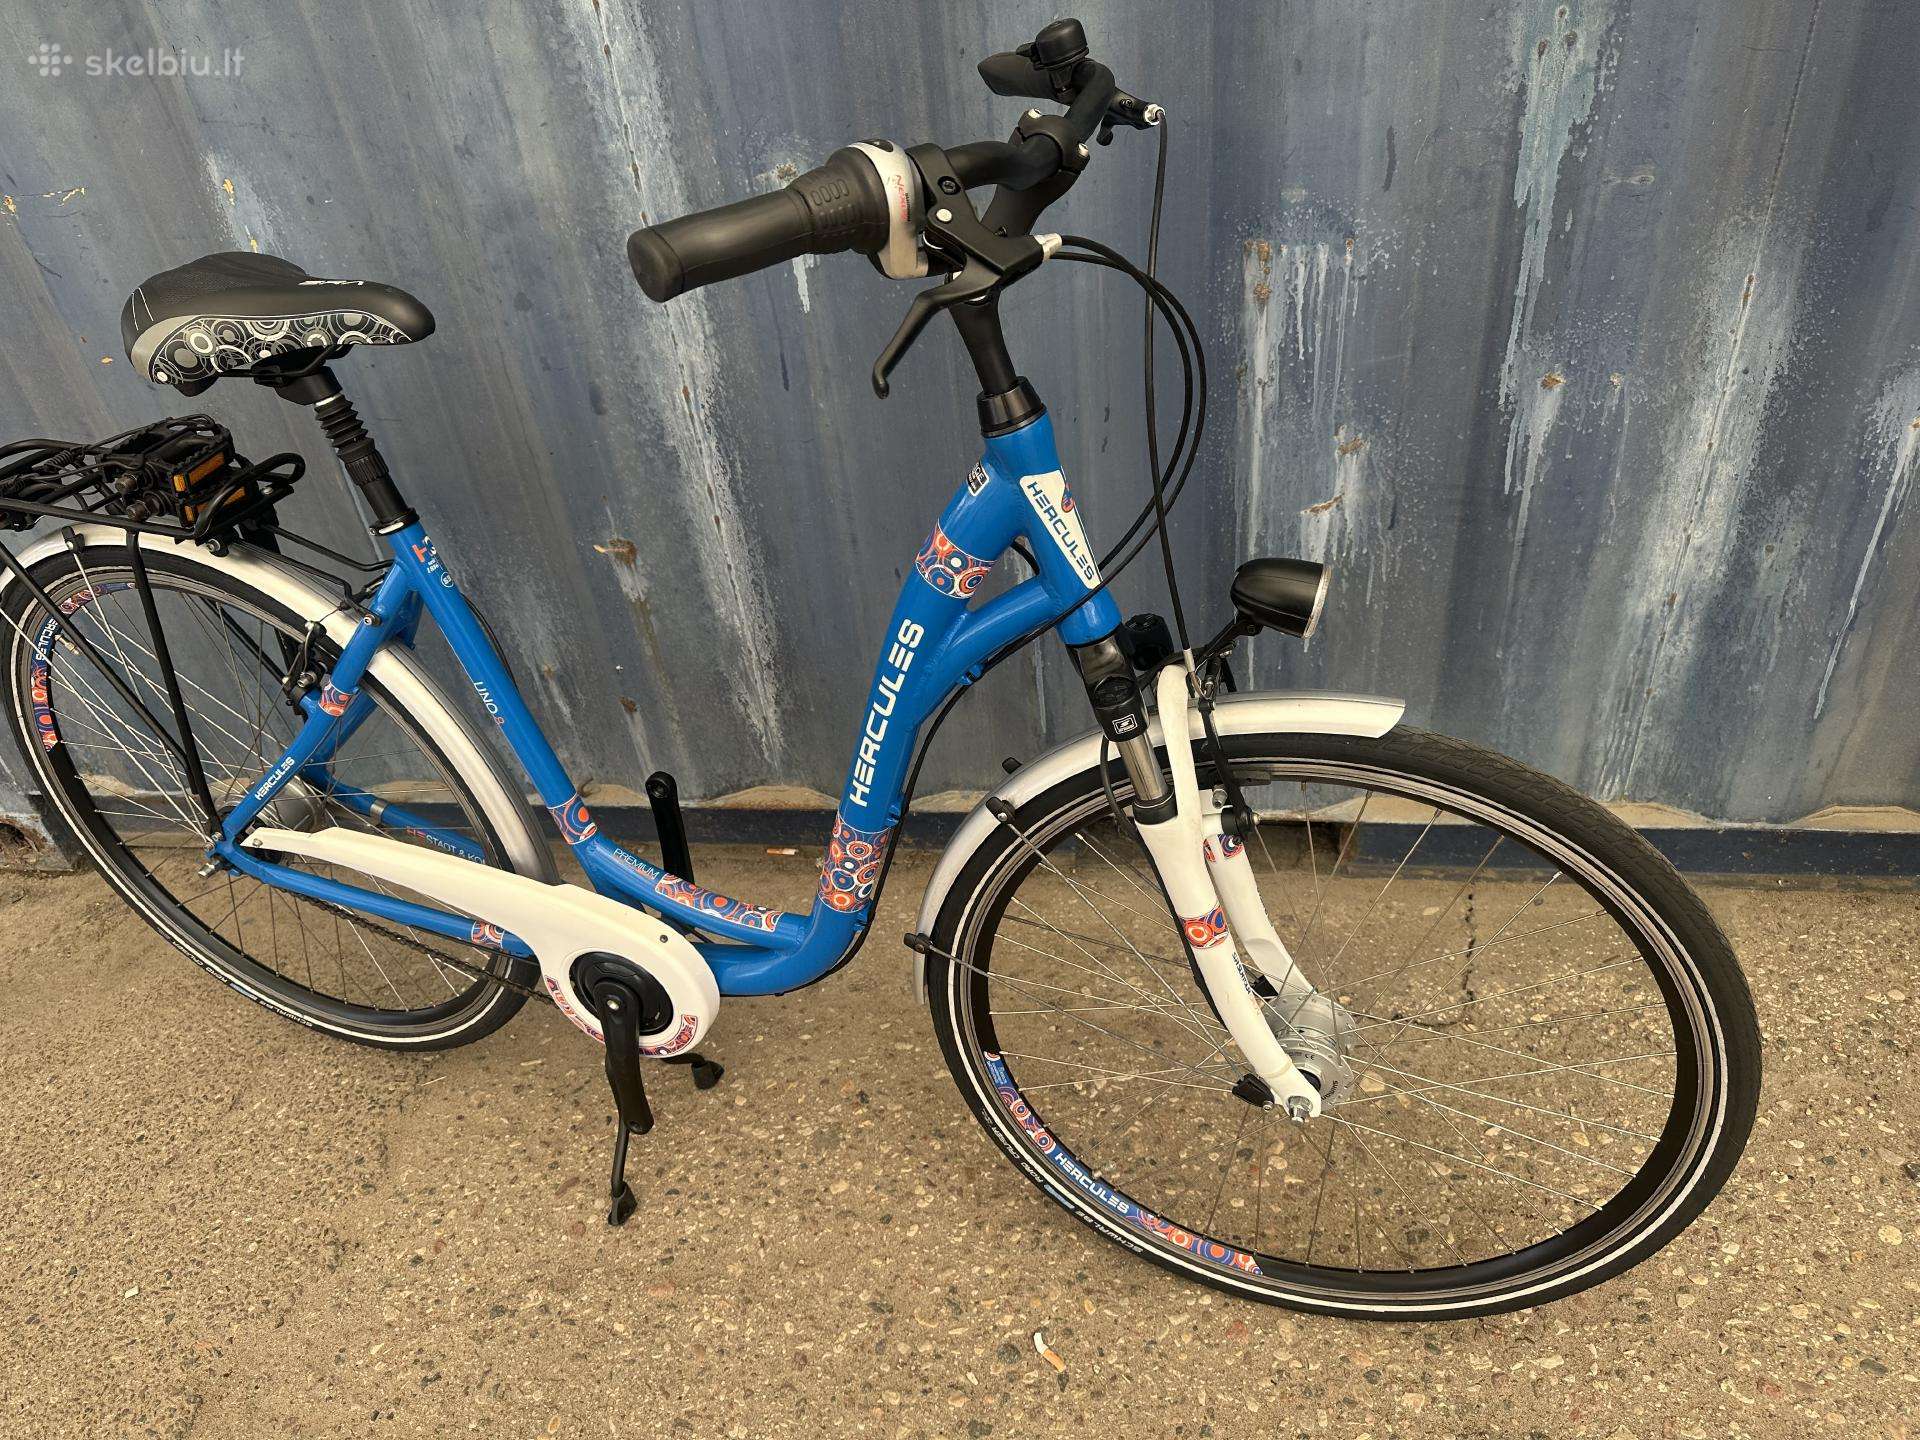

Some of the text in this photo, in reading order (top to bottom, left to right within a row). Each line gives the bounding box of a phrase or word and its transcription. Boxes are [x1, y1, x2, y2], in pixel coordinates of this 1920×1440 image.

[1026, 481, 1095, 581] HERCULES
[36, 618, 58, 661] ERCULES
[850, 618, 925, 807] HERCULES
[254, 756, 295, 801] HERCULES
[613, 848, 660, 880] PREMIUM
[1054, 1151, 1130, 1214] HERCULES
